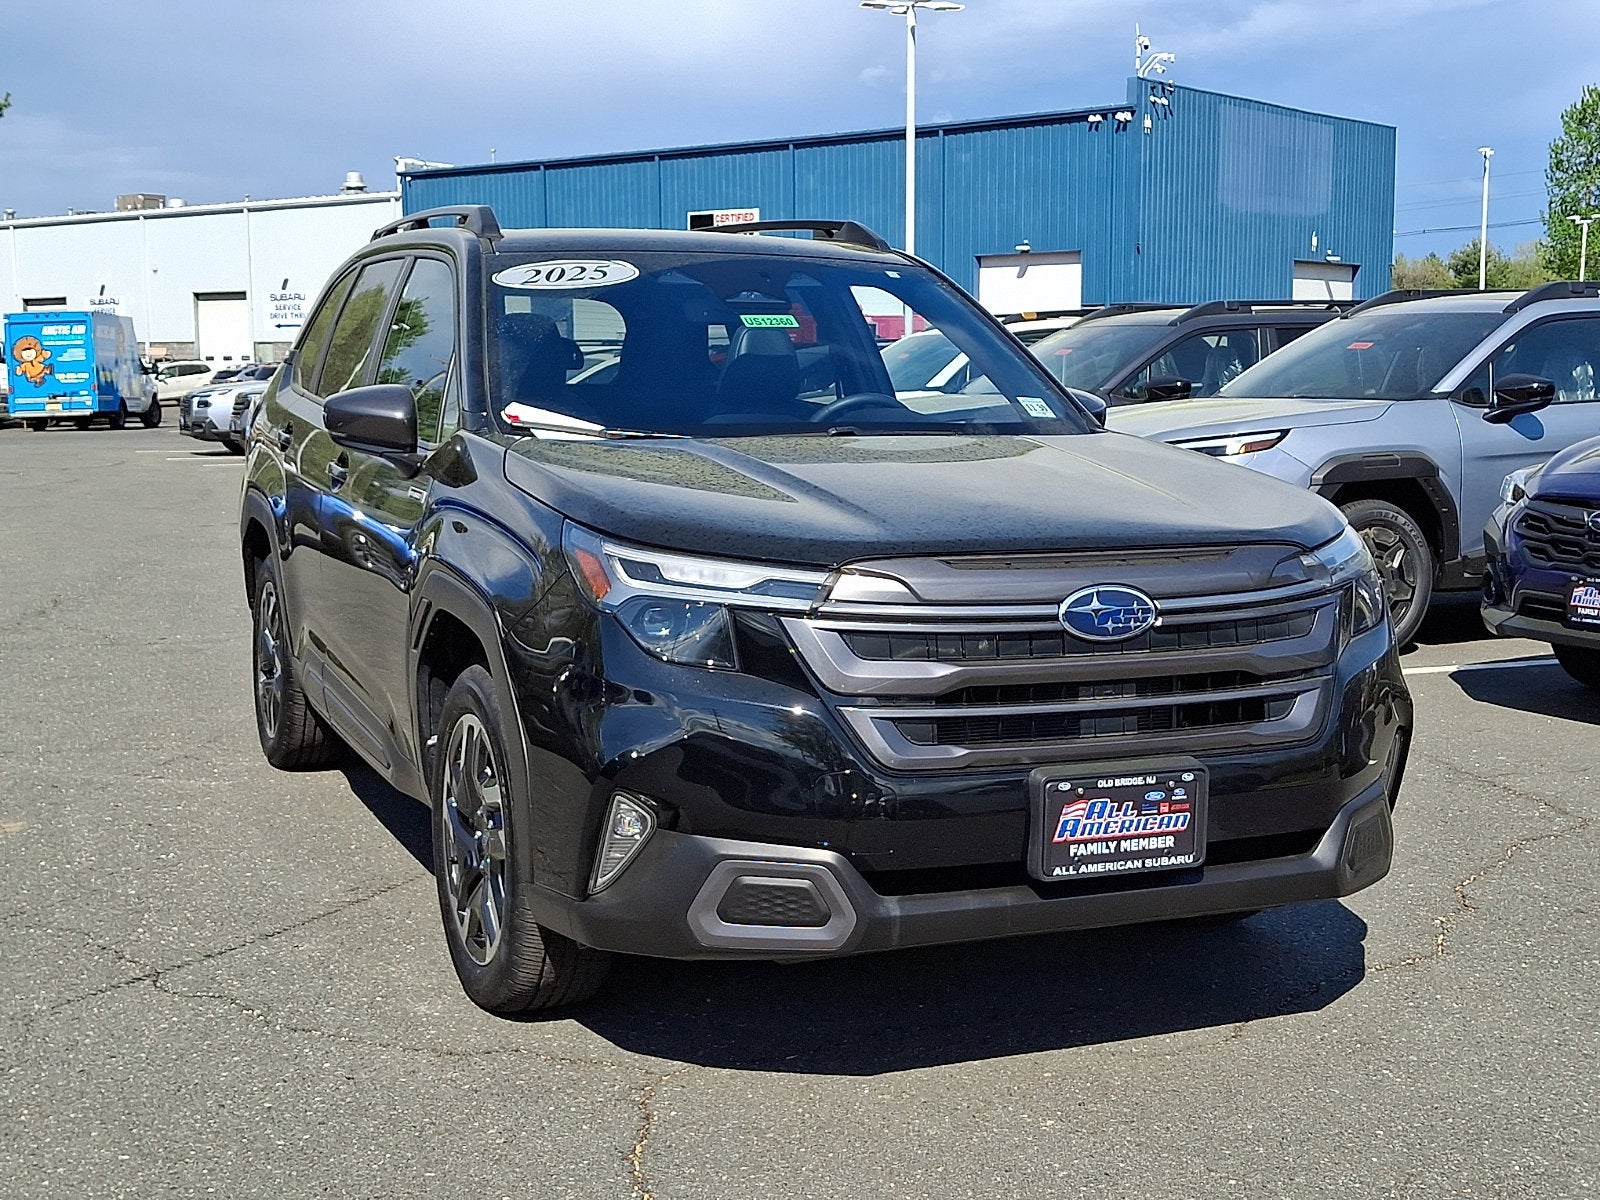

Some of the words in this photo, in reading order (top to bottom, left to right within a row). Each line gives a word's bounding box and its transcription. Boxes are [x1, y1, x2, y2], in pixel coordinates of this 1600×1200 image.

[715, 213, 754, 222] CERTIFIED
[521, 263, 610, 285] 2025
[270, 293, 305, 301] SUBARU
[744, 317, 793, 326] US12360
[1097, 778, 1113, 788] OLD
[1146, 776, 1156, 784] NJ
[1085, 799, 1137, 821] ALL
[1056, 813, 1190, 840] AMERICAN
[1069, 839, 1118, 857] FAMILY
[1120, 836, 1175, 852] MEMBER
[1052, 865, 1077, 876] ALL
[1079, 860, 1144, 874] AMERICAN
[1145, 854, 1193, 867] SUBARU
